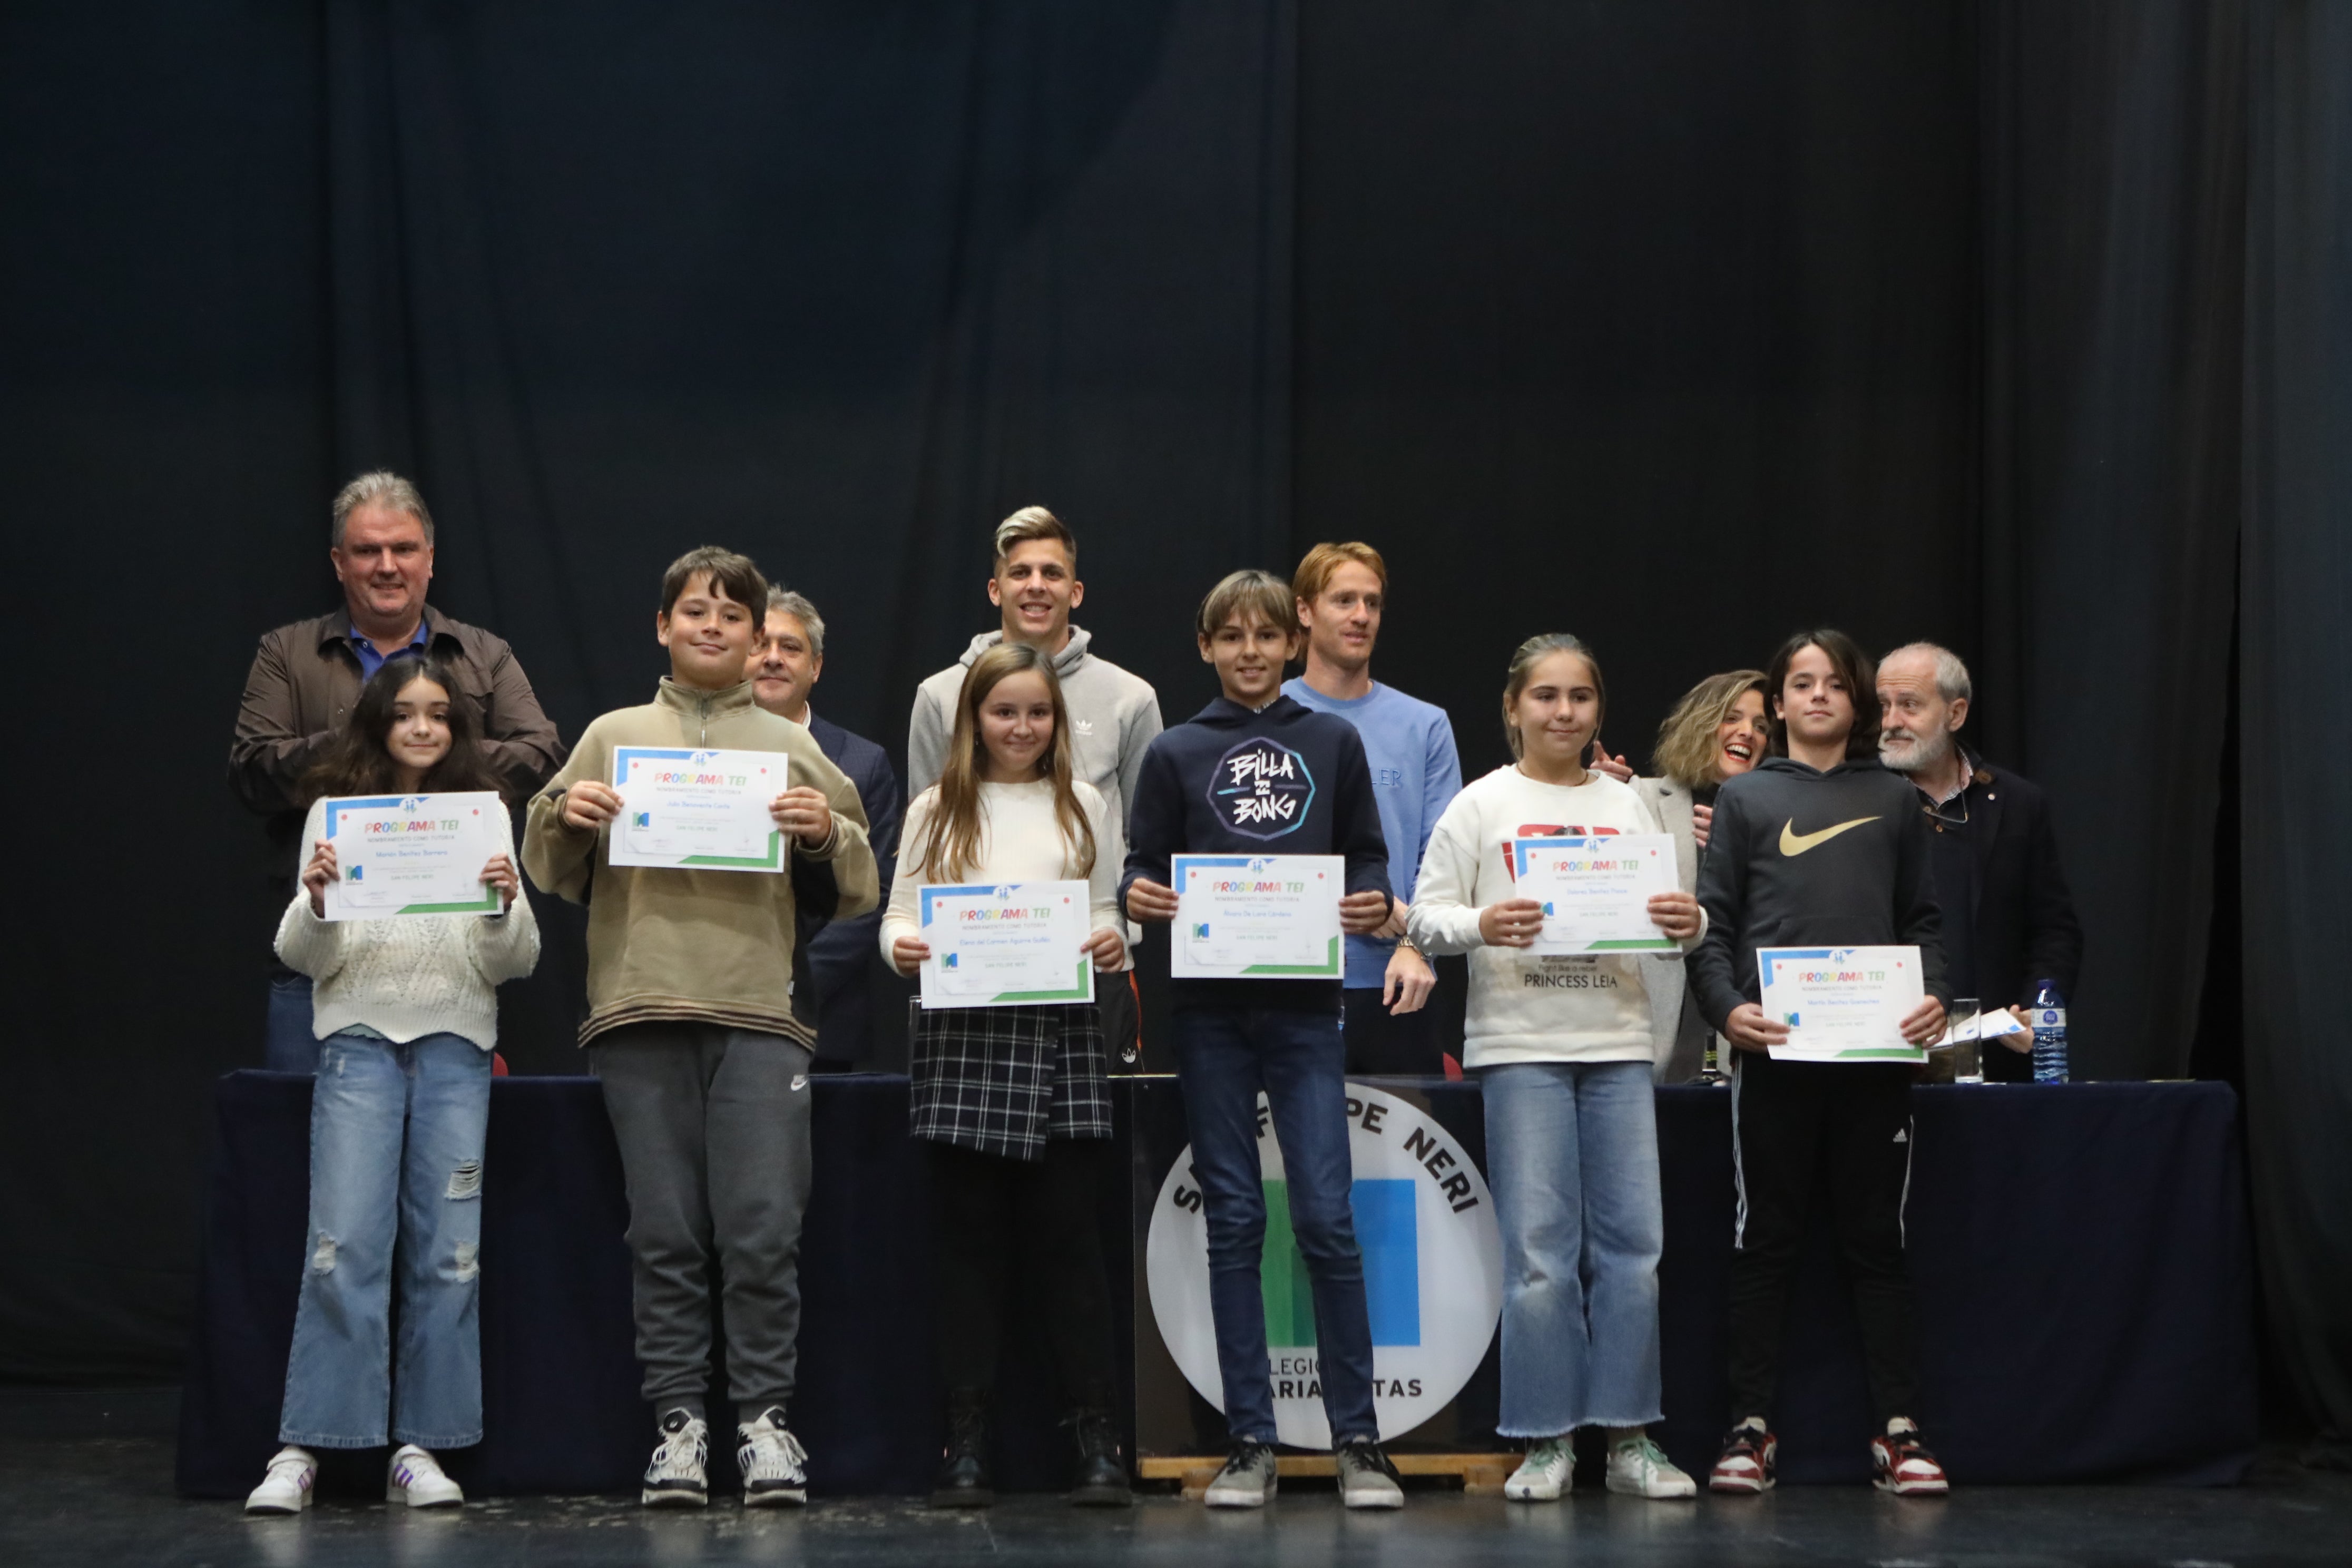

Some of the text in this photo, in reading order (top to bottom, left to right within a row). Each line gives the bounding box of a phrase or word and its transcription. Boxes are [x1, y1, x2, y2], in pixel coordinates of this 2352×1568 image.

[654, 772, 747, 786] PROGRAMA TEI
[1233, 793, 1296, 825] BONG
[365, 820, 459, 834] PROGRAMA TEI
[1553, 860, 1639, 872] PROGRAMA TEI
[1213, 881, 1304, 893] PROGRAMA TEI
[959, 908, 1050, 921] PROGRAMA TEI
[1524, 975, 1618, 988] PRINCESS LEIA
[1799, 971, 1885, 982] PROGRAMA TEI
[1403, 1126, 1478, 1214] NERI
